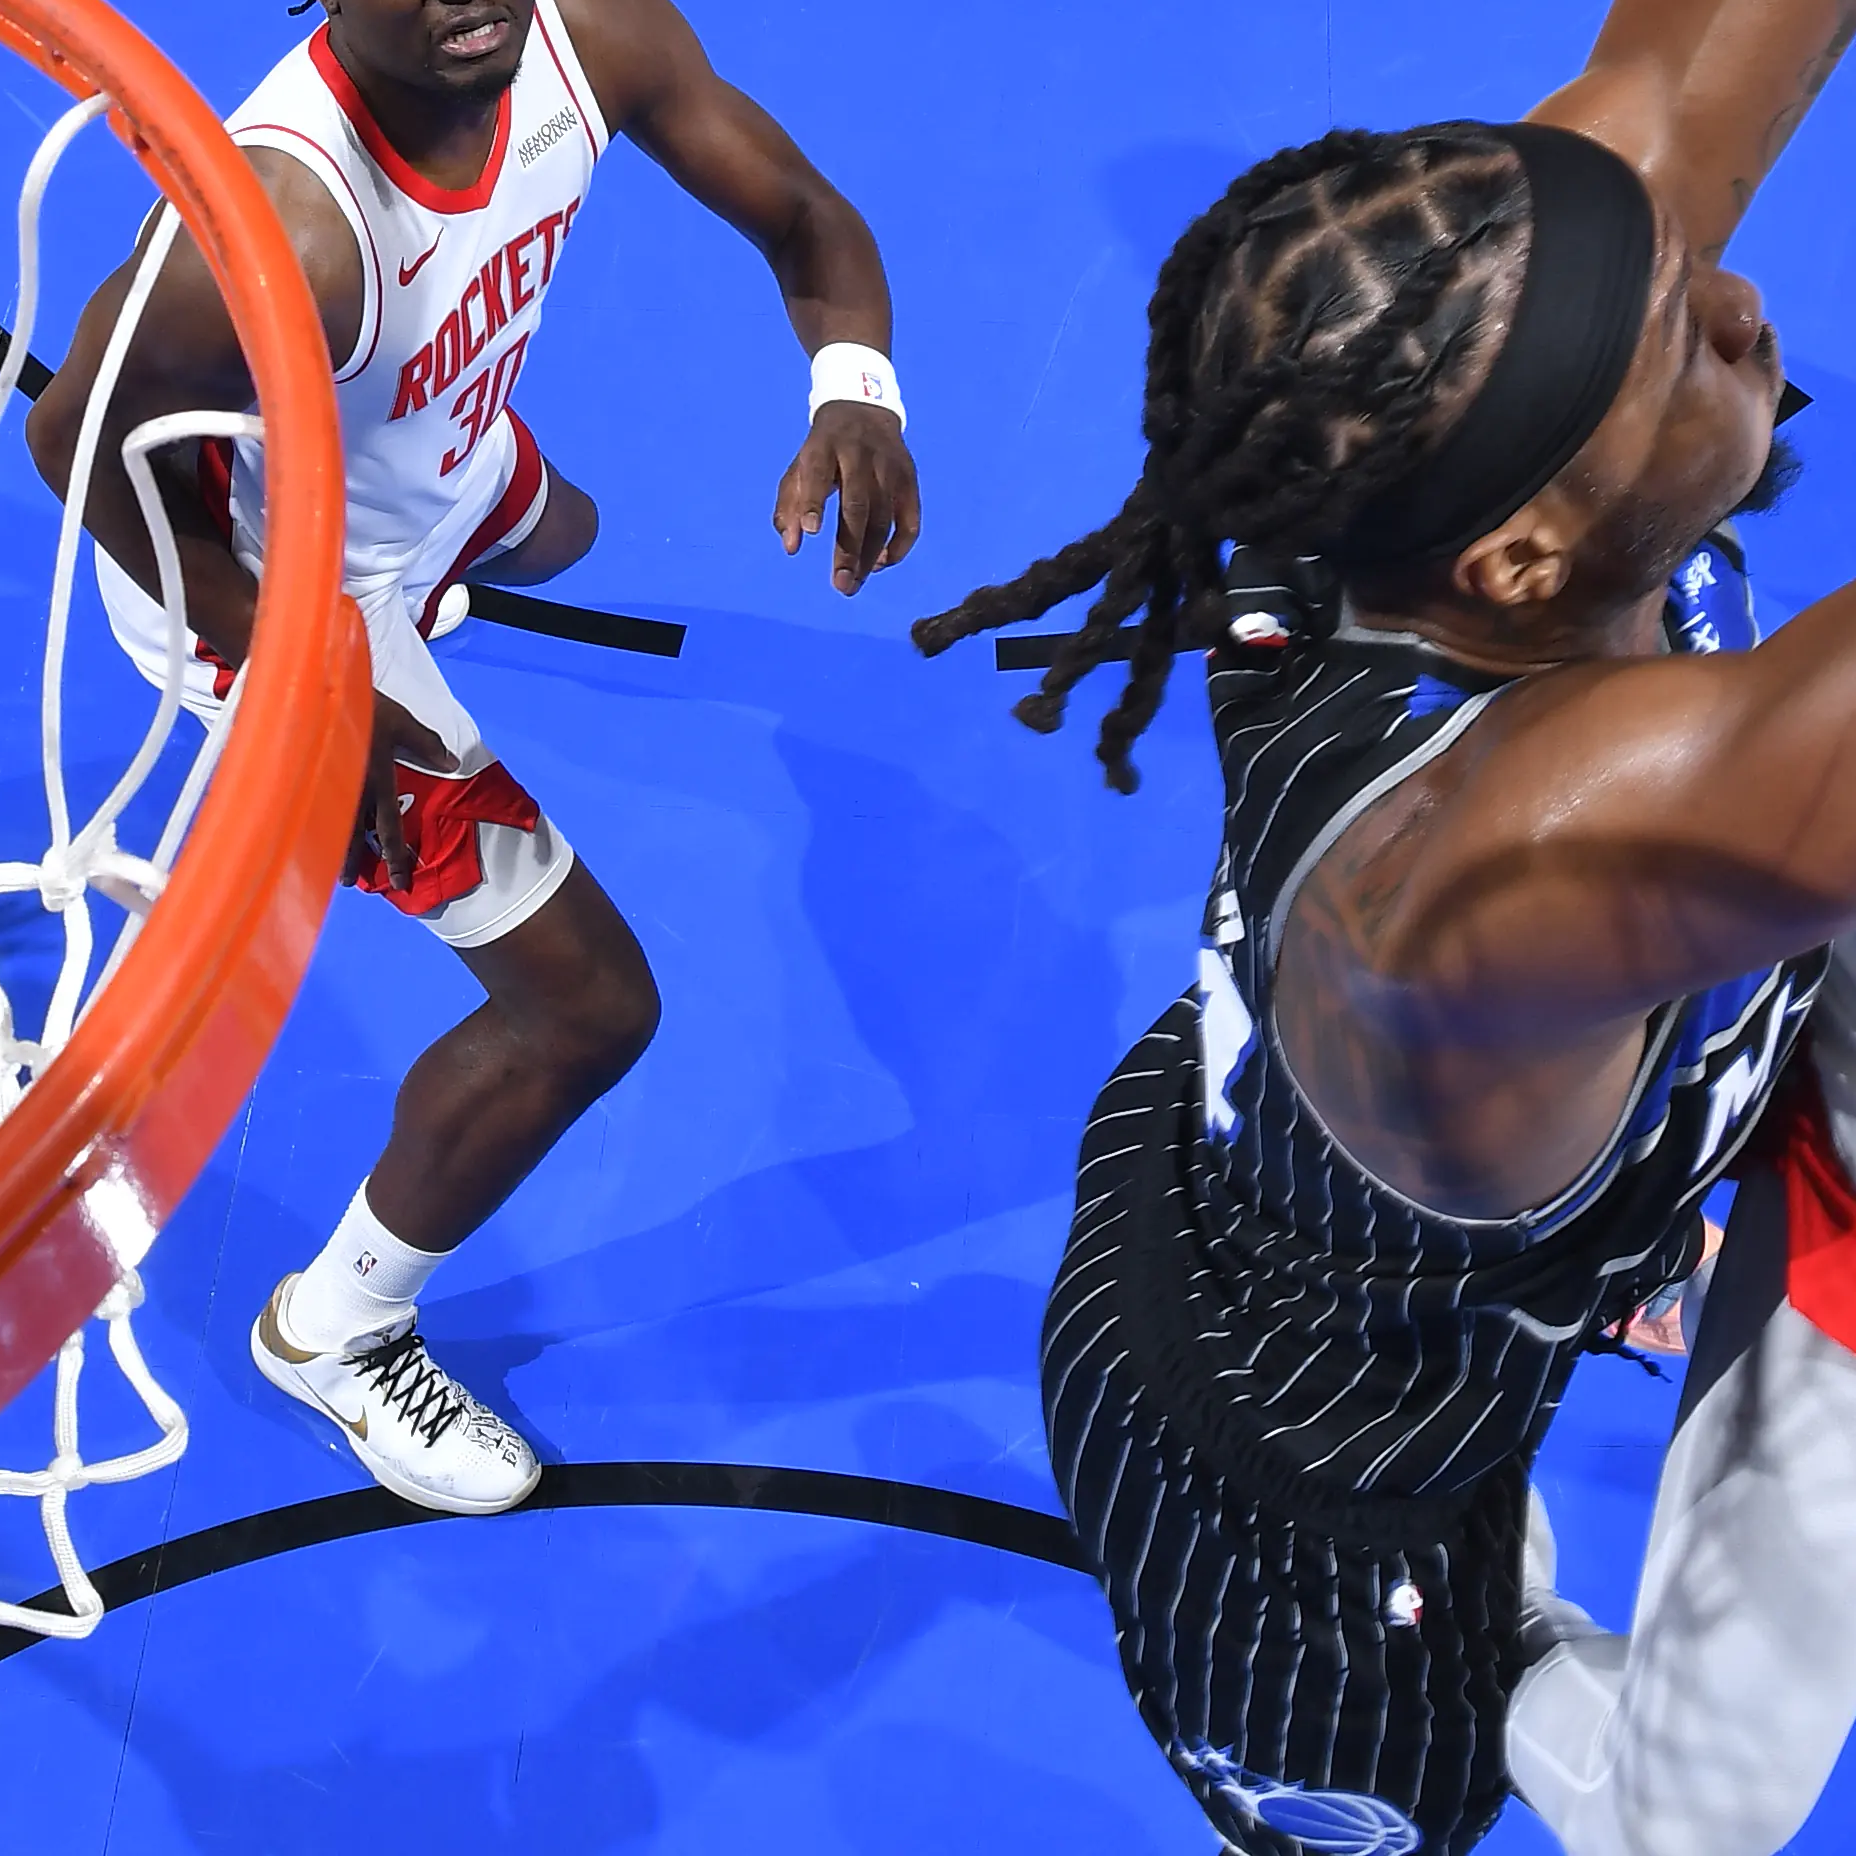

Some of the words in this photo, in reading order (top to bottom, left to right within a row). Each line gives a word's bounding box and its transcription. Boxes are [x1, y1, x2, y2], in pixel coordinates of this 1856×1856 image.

[517, 106, 575, 154] MEMORIAL
[520, 113, 578, 169] HERMANN
[440, 330, 530, 477] 30
